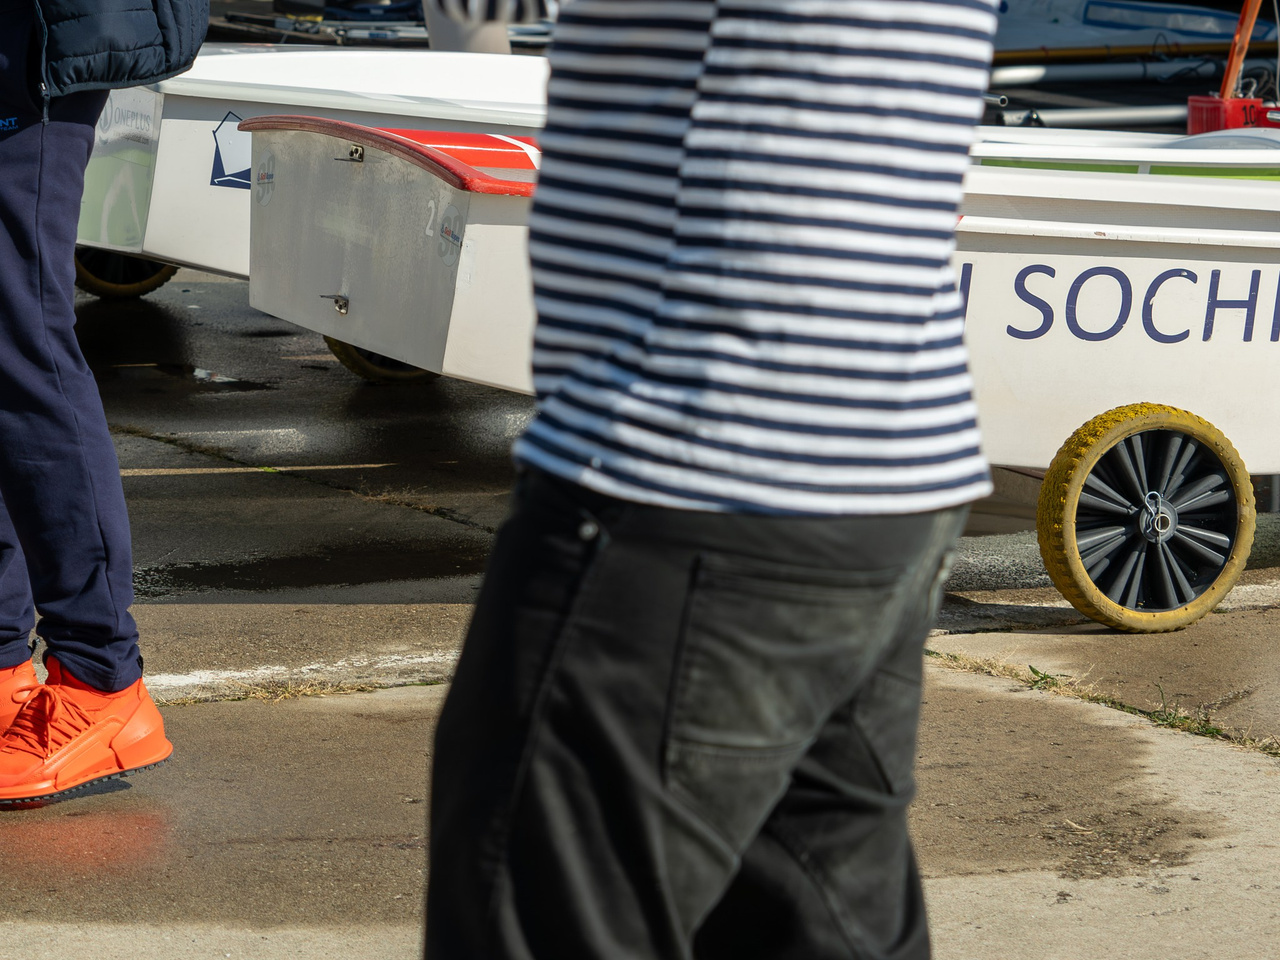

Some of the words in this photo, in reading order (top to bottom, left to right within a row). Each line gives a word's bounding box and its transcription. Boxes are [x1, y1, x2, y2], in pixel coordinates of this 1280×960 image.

[114, 107, 151, 132] ONEPLUS
[1242, 104, 1256, 124] 10
[425, 199, 435, 237] 2
